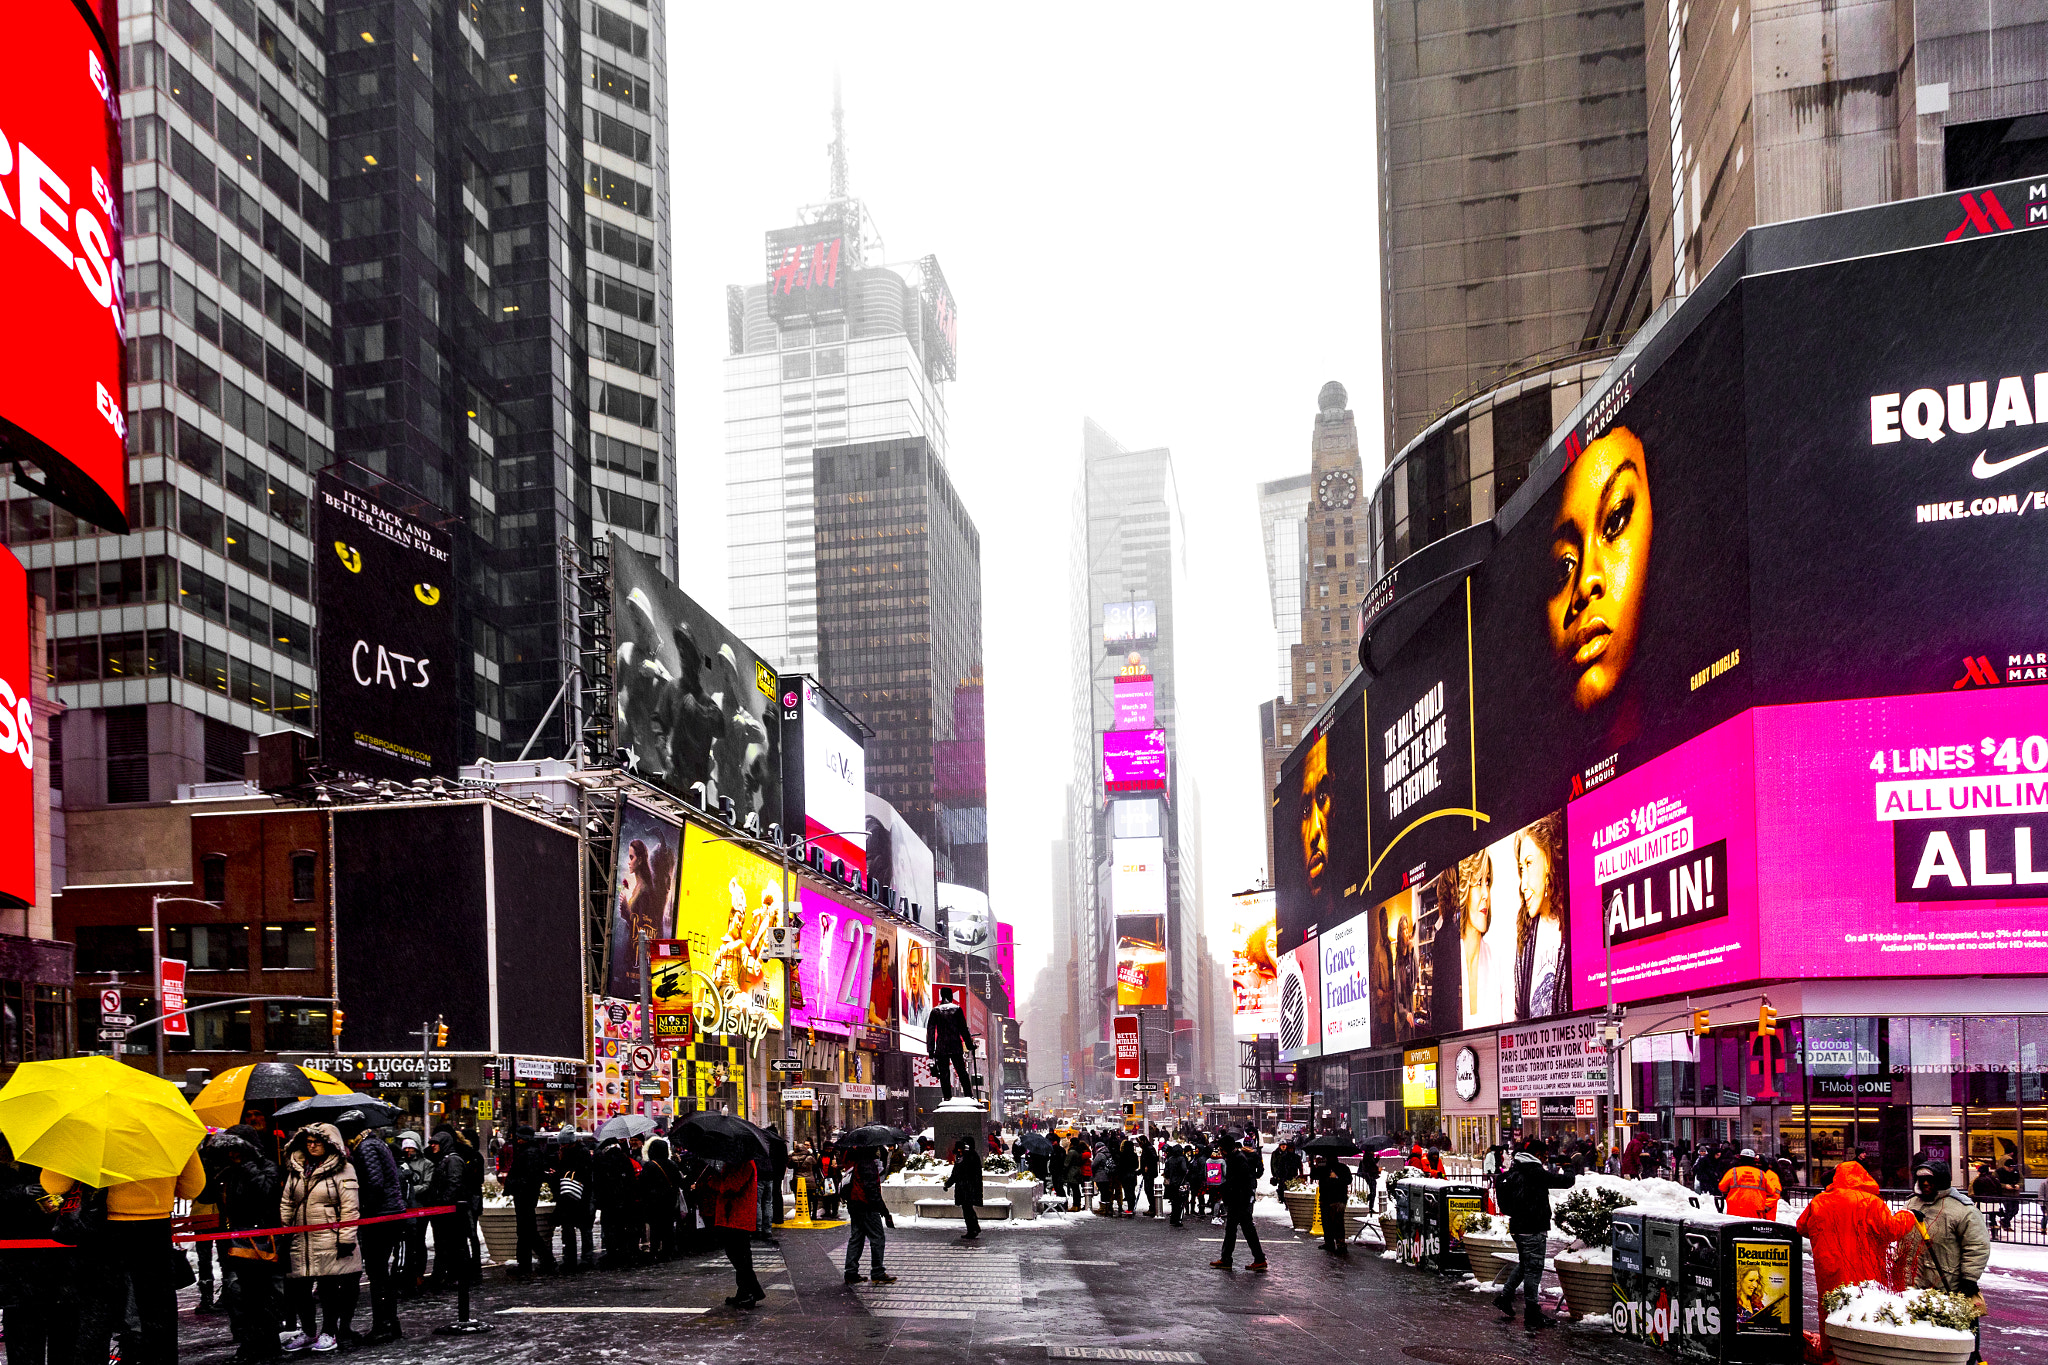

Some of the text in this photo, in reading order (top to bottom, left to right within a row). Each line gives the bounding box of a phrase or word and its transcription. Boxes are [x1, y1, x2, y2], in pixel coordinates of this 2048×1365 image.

[1585, 363, 1637, 430] MARRIOTT
[1586, 388, 1631, 447] MARQUIS
[343, 490, 367, 510] IT'S
[371, 503, 402, 529] BACK
[405, 523, 431, 541] AND
[376, 519, 411, 544] THAN
[1363, 570, 1399, 609] MARRIOTT
[1110, 606, 1149, 623] 3:02
[1363, 589, 1395, 626] MARQUIS
[352, 640, 430, 689] CATS
[1120, 665, 1147, 676] 2017
[1690, 648, 1740, 692] GABBY DOUGLAS
[1115, 675, 1152, 684] TOSHIBA
[785, 711, 798, 720] LG
[1384, 680, 1444, 760] THE BALL SHOULD
[354, 732, 431, 761] CATSBROADWAY.COM
[1384, 713, 1448, 793] BOUNCE THE SAME
[1585, 752, 1619, 779] MARRIOTT
[1869, 750, 1886, 775] 4
[1892, 744, 1975, 773] LINES
[461, 779, 498, 790] LAMAR
[1105, 779, 1165, 792] TOSHIBA
[1389, 756, 1442, 821] FOR EVERYONE.
[1585, 767, 1616, 790] MARQUIS
[1656, 796, 1669, 808] EACH
[1667, 799, 1682, 815] MONTH
[1884, 788, 1943, 813] ALL
[1592, 800, 1657, 850] 4 LINES $40
[689, 781, 922, 920] 1540 BROADWAY
[1597, 826, 1689, 880] ALL UNLIMITED
[1911, 826, 2048, 889] ALL
[1609, 855, 1715, 937] ALL IN!
[688, 930, 710, 956] FEEL
[1845, 929, 2041, 942] On all T-Mobile plans, if congested, top 3% of data
[1881, 943, 1912, 951] Activate
[1913, 942, 1926, 951] HD
[1927, 942, 1956, 950] feature
[1996, 940, 2009, 949] for
[2010, 940, 2023, 948] HD
[2024, 940, 2048, 948] video.
[838, 918, 878, 1011] 21
[1325, 945, 1355, 976] Grace
[1117, 974, 1144, 986] ARTOIS
[1119, 967, 1145, 980] STELLA
[752, 989, 779, 1012] LION KING
[1327, 971, 1367, 1010] Frankie
[658, 1015, 688, 1026] Miss
[658, 1025, 688, 1035] Saigon
[1515, 1031, 1539, 1047] TOKYO
[1540, 1030, 1550, 1045] TO
[1552, 1025, 1577, 1043] TIMES
[1501, 1040, 1582, 1063] PARIS LONDON NEW YORK
[1815, 1051, 1847, 1063] DATA
[303, 1059, 451, 1072] GIFTS LUGGAGE
[1501, 1063, 1514, 1075] HONG
[1515, 1062, 1529, 1074] KONG
[1530, 1059, 1554, 1072] TORONTO
[1555, 1056, 1585, 1070] SHANGHAI
[1509, 1074, 1526, 1083] ANGELES
[1526, 1072, 1549, 1082] SINGAPORE
[1550, 1071, 1570, 1080] ANTWERP
[1450, 1199, 1480, 1209] Beautiful
[1737, 1246, 1789, 1261] Beautiful
[1655, 1266, 1672, 1279] PAPER
[1695, 1275, 1713, 1288] TRASH
[1611, 1298, 1721, 1342] @TSqArts
[1064, 1346, 1197, 1364] BEAUMONT
